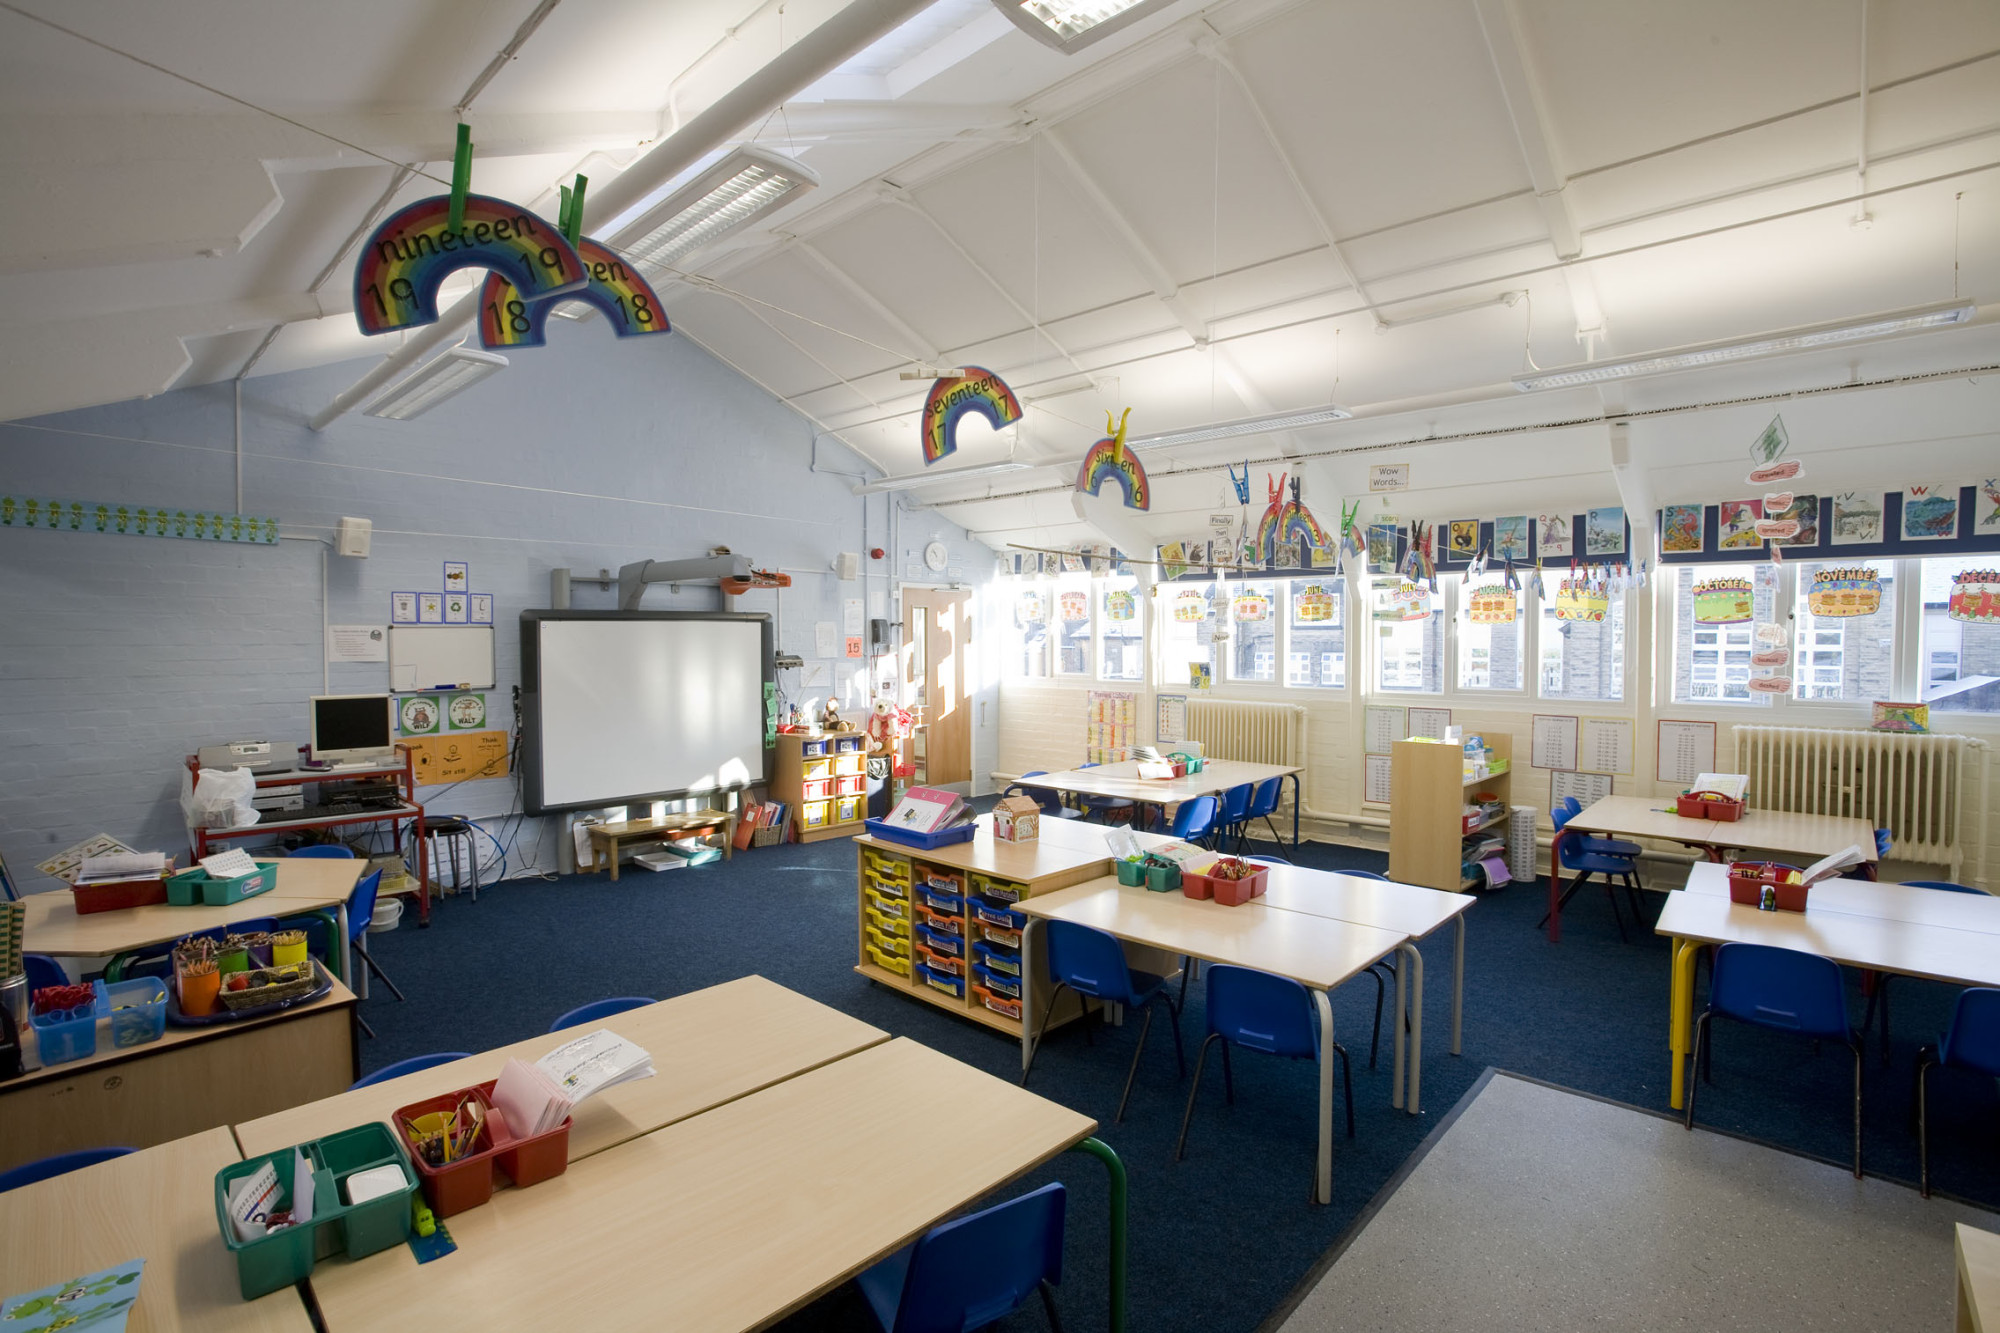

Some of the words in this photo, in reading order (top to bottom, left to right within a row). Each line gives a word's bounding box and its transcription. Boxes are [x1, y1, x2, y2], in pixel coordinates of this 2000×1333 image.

[376, 214, 537, 265] nineteen
[518, 247, 565, 284] 19
[365, 277, 420, 318] 19
[487, 300, 532, 334] 18
[614, 293, 654, 325] 18
[926, 374, 999, 418] seventeen
[990, 394, 1008, 419] 17
[929, 423, 947, 450] 17
[1086, 467, 1098, 488] 16
[1128, 483, 1143, 502] 16
[1911, 486, 1928, 496] W
[1211, 517, 1231, 525] Finally
[1540, 515, 1547, 523] Q
[1590, 511, 1598, 522] R
[1667, 507, 1675, 517] S
[1700, 580, 1746, 591] OCTOBER
[1814, 570, 1878, 582] NOVEMBER
[1480, 586, 1507, 595] AUGUST
[848, 643, 860, 653] 15
